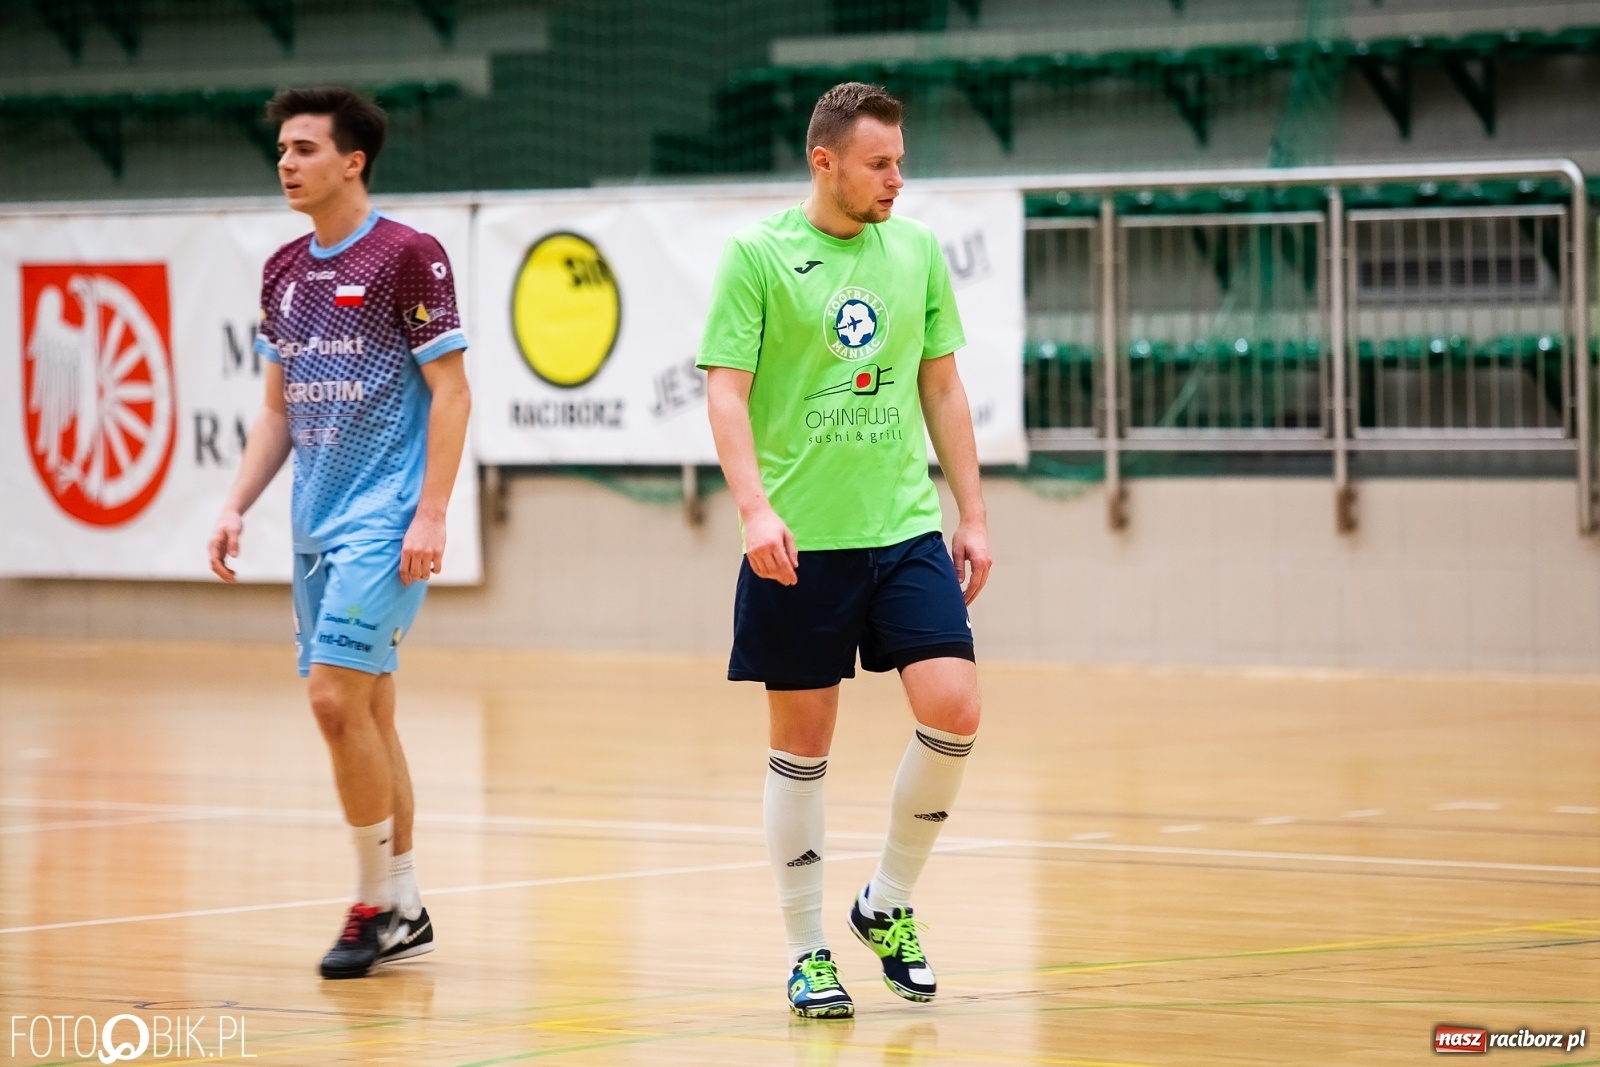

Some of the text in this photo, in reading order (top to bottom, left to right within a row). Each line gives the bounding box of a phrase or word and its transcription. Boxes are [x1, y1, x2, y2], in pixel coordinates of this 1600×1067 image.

[279, 281, 297, 318] 4
[827, 290, 884, 318] FOOTBALL
[831, 339, 881, 359] MANIAC
[805, 407, 900, 429] OKINAWA
[808, 430, 902, 445] sushi & grill
